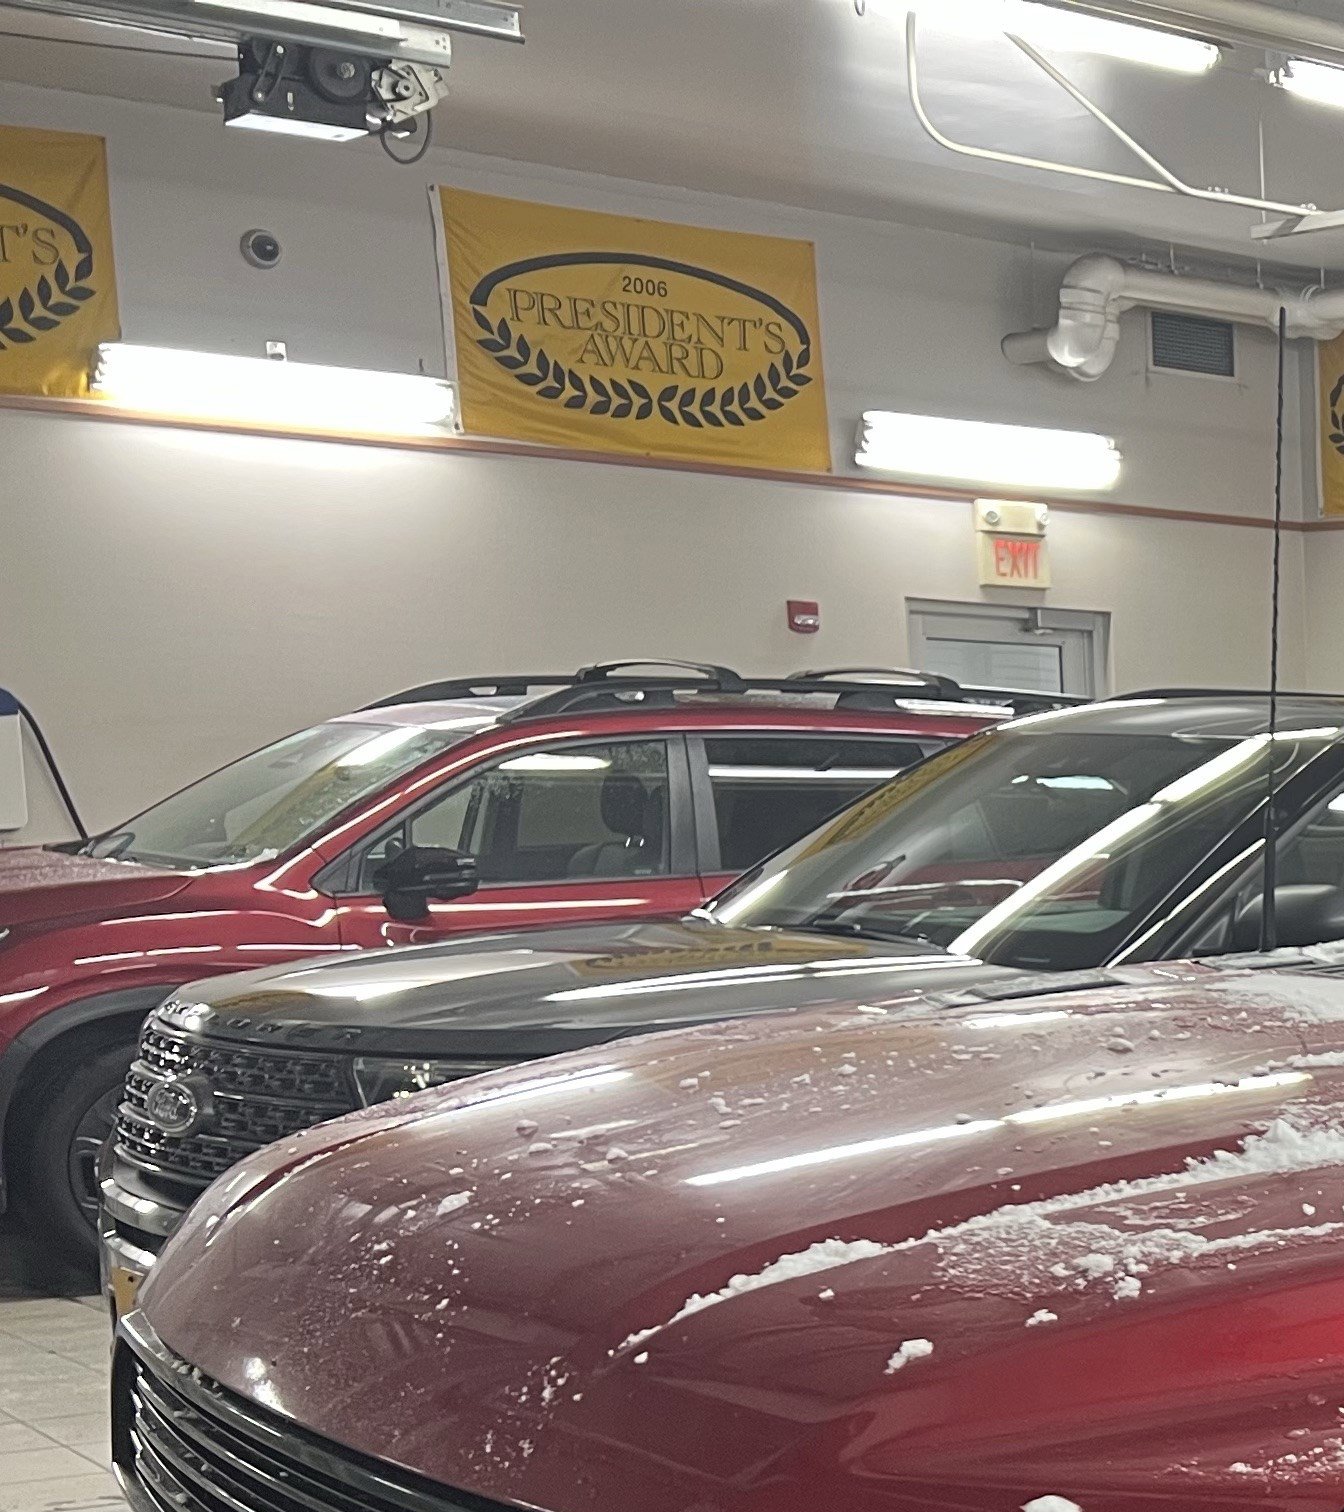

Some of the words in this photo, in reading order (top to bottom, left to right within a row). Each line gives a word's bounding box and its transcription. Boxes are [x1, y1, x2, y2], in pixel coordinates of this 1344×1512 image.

[621, 275, 669, 298] 2006
[504, 287, 787, 355] PRESIDENT'S
[574, 332, 724, 381] AWARD
[993, 538, 1041, 580] EXIT
